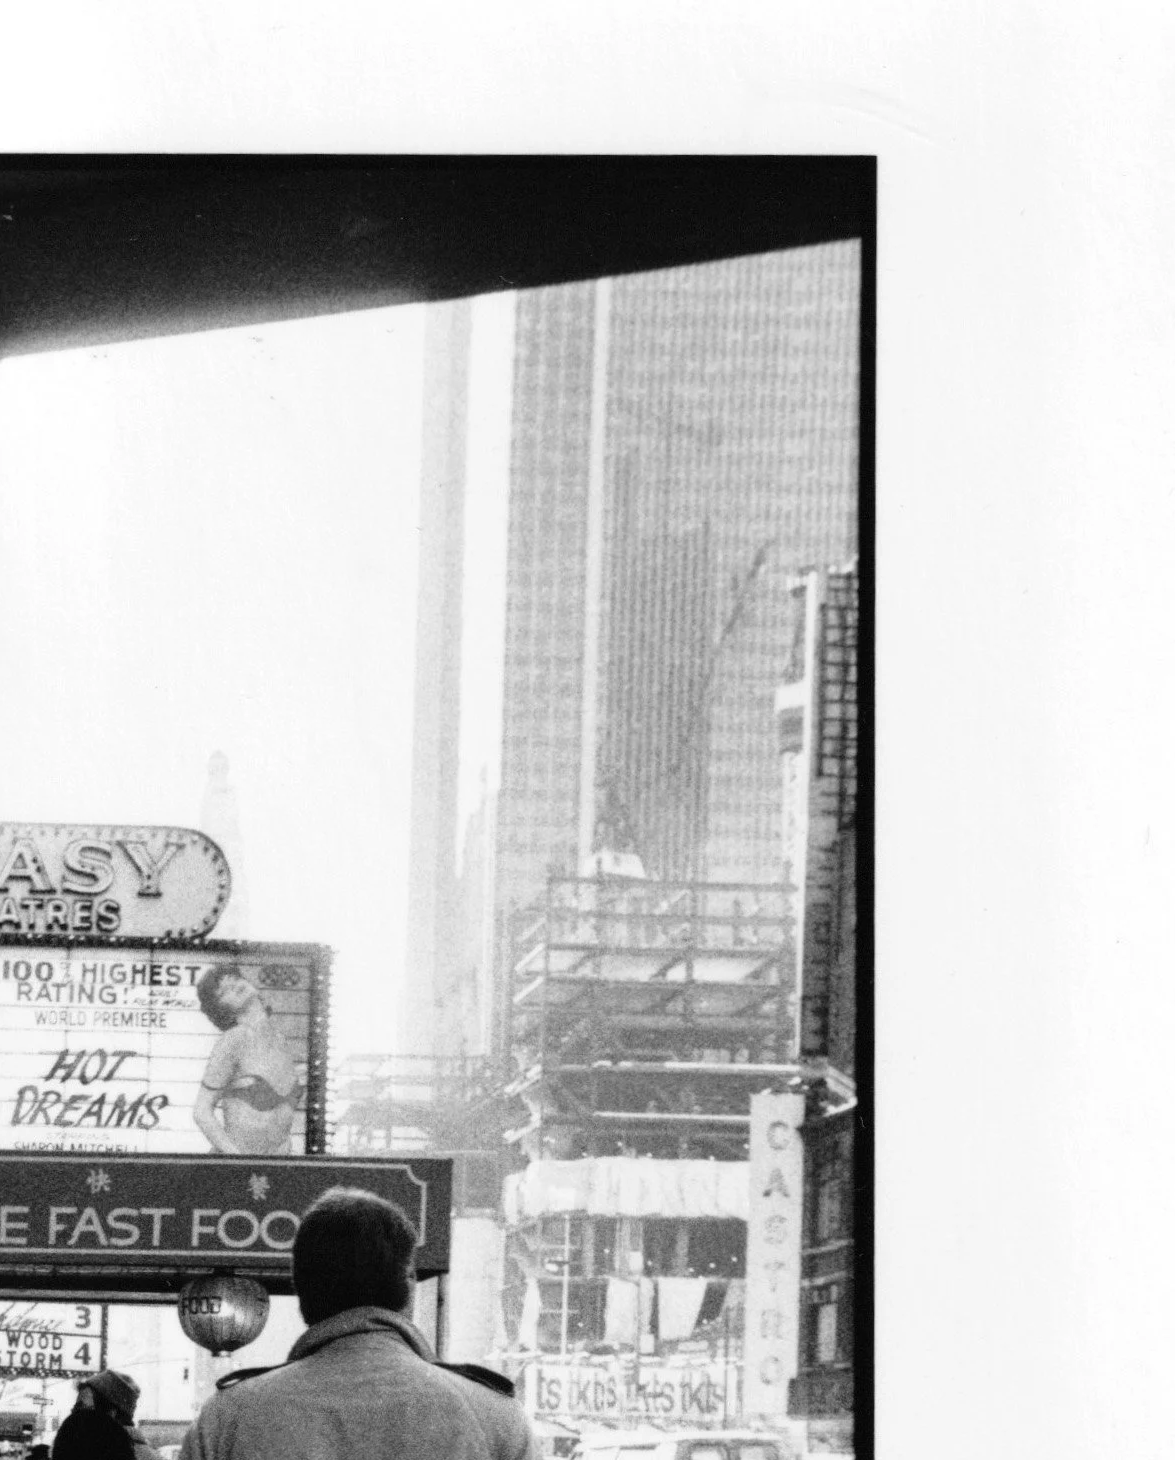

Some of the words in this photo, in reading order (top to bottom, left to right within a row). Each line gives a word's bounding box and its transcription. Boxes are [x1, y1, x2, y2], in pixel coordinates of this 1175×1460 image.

[81, 962, 202, 987] HIGHEST
[34, 1010, 86, 1026] WORLD
[93, 1011, 167, 1029] PREMIERE
[44, 1047, 138, 1086] HOT
[10, 1084, 169, 1130] DREAMS
[47, 1206, 176, 1247] FAST
[190, 1208, 302, 1251] FOO
[73, 1305, 92, 1330] 3
[6, 1329, 63, 1351] WOOD
[73, 1342, 92, 1366] 4
